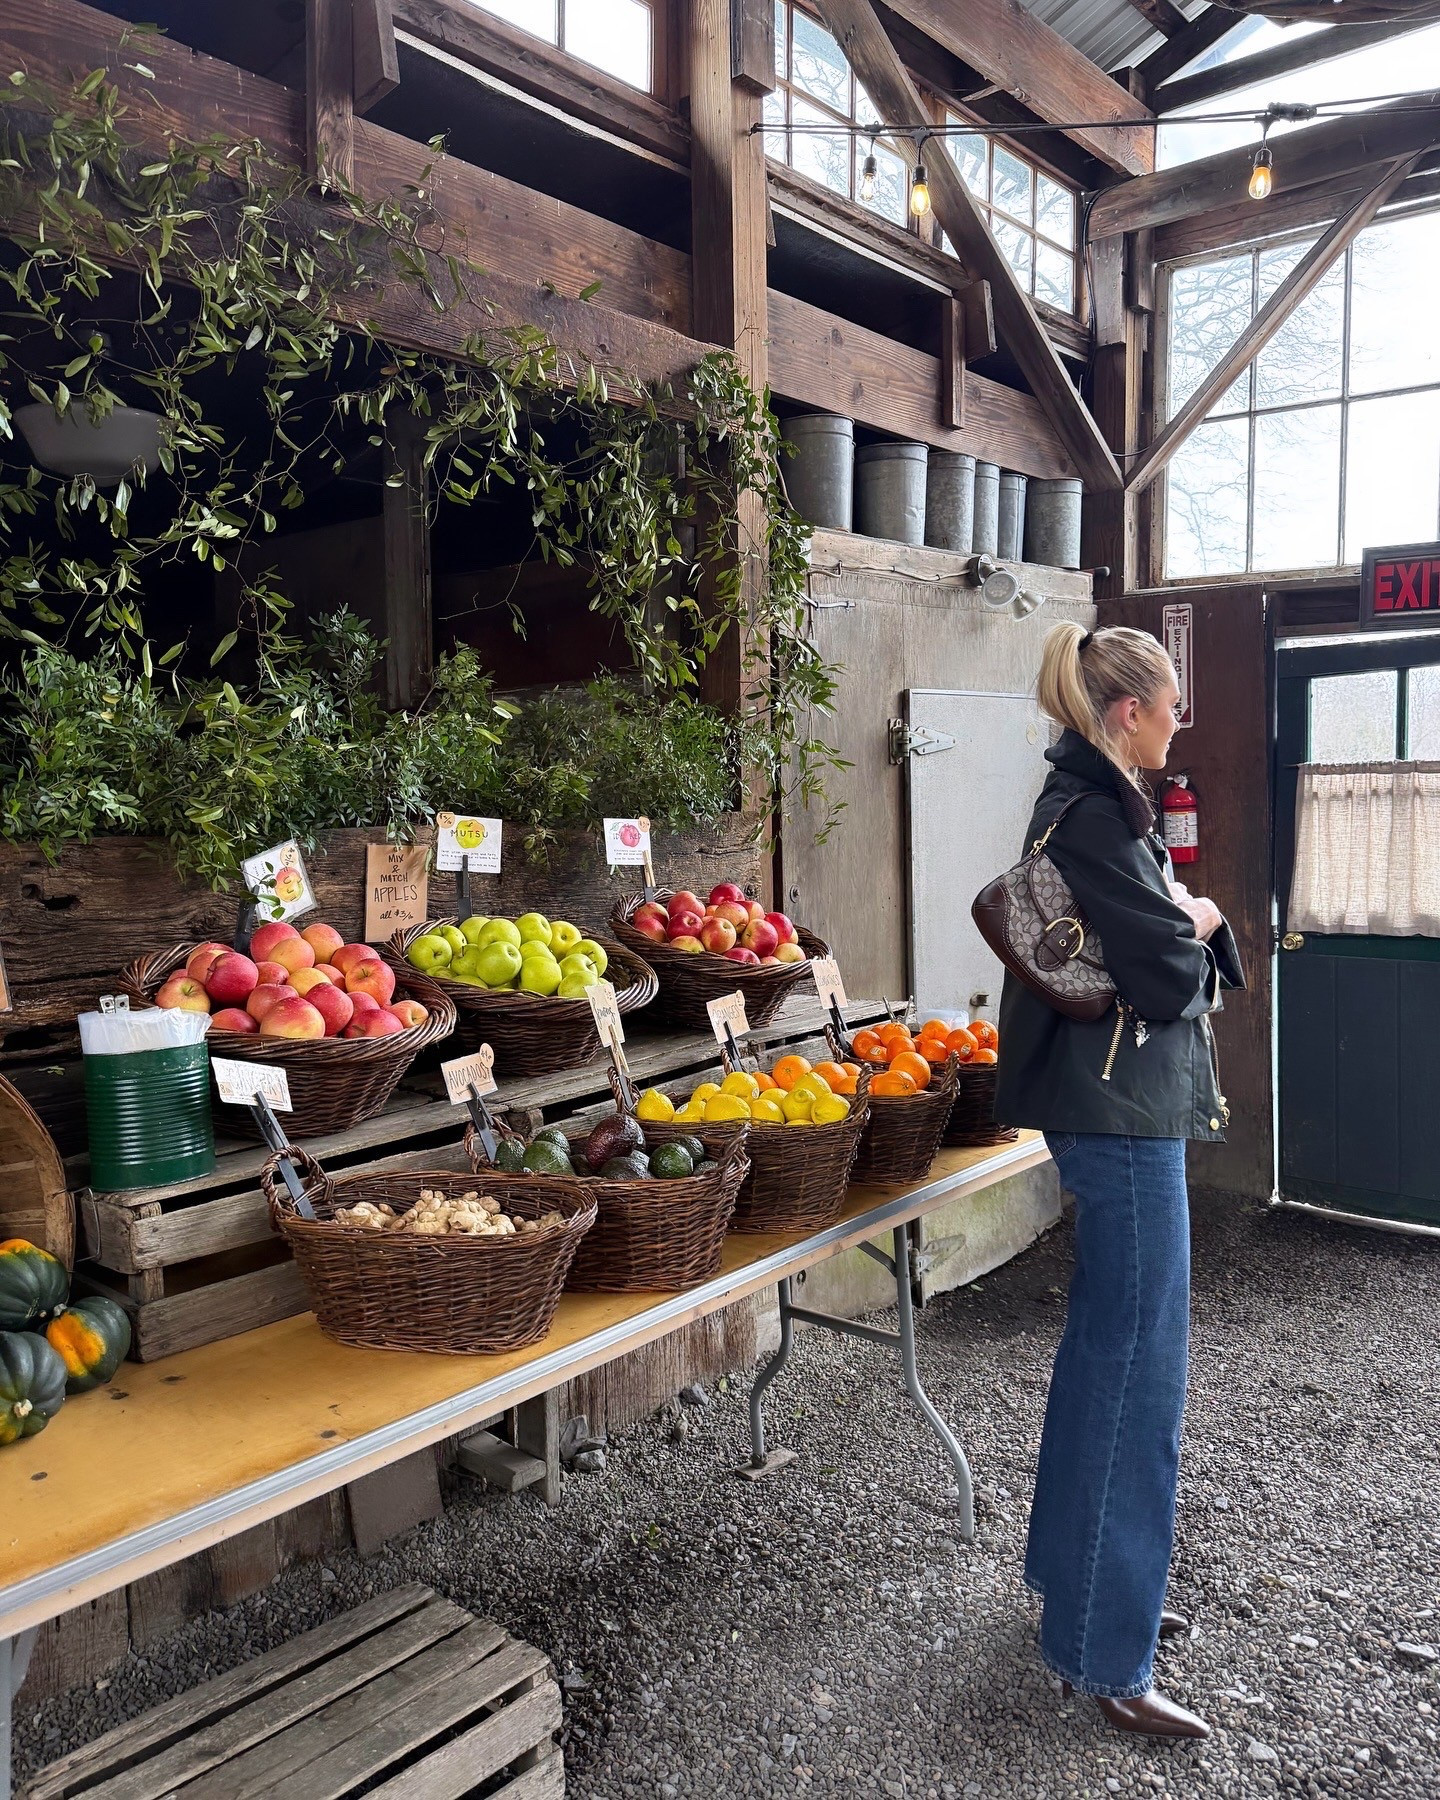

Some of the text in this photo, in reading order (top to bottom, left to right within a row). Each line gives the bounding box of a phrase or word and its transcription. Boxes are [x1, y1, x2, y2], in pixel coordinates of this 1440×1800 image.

[1167, 615, 1188, 627] FIRE
[1174, 628, 1182, 717] EXTINGER
[450, 829, 489, 839] MUTSU
[388, 853, 404, 863] MIX
[391, 864, 400, 874] &
[380, 872, 408, 883] MATCH
[374, 884, 418, 903] APPLES
[380, 910, 392, 920] all
